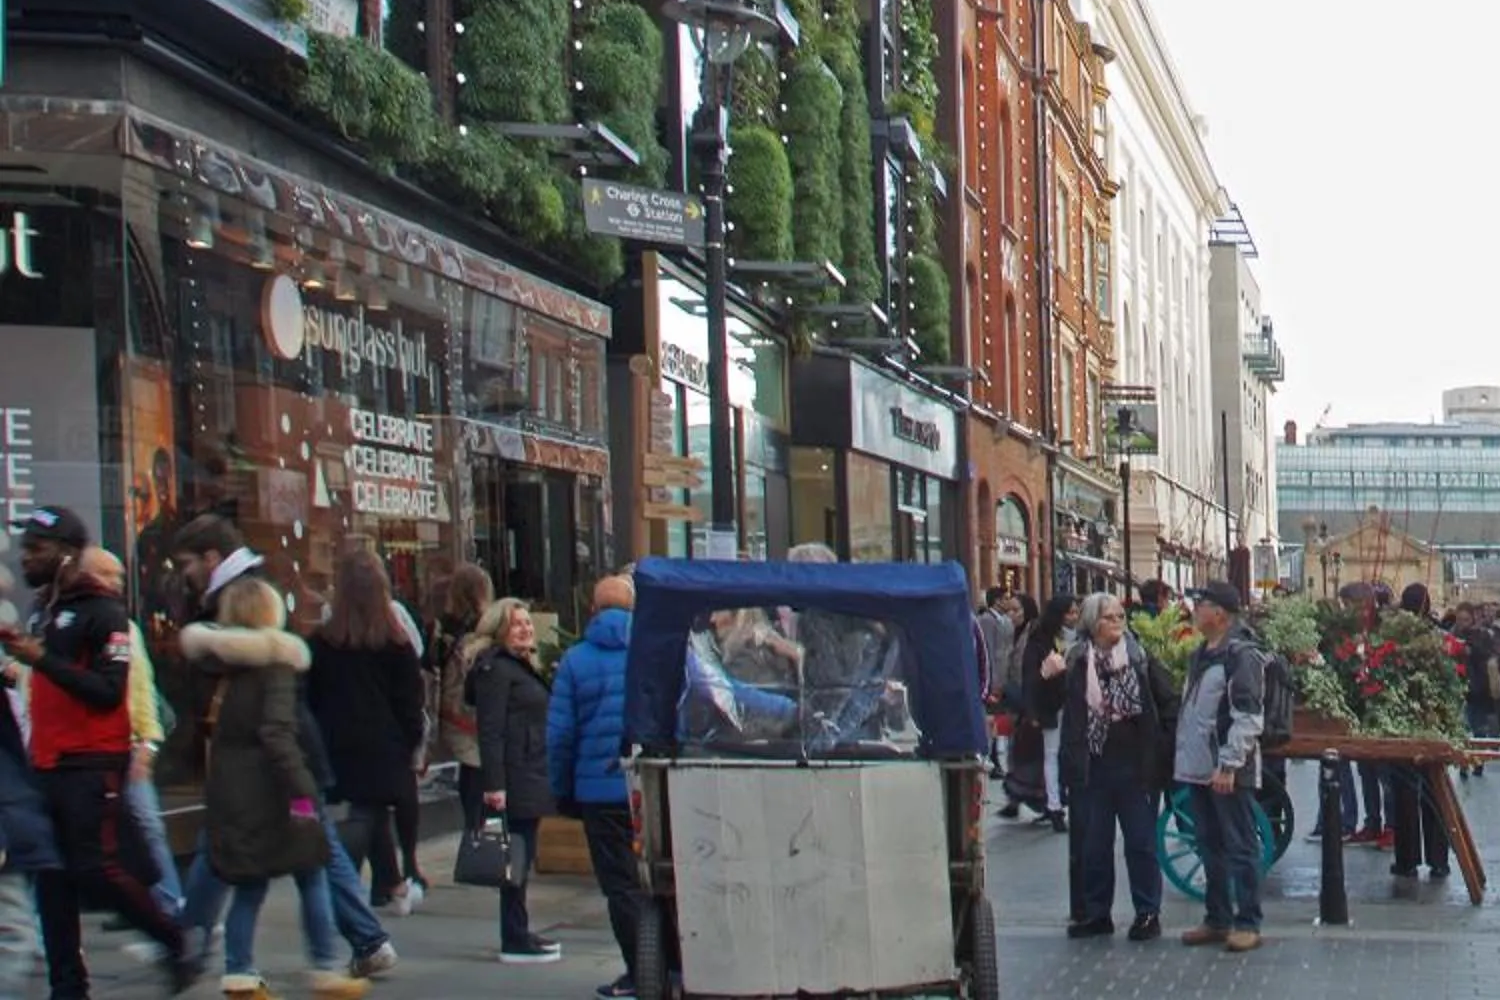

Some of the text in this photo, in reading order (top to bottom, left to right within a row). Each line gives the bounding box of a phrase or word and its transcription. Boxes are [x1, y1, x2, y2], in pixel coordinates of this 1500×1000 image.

[606, 185, 682, 209] Charing Cross
[644, 206, 683, 224] Station
[305, 304, 428, 379] sunglass hut
[350, 408, 433, 452] CELEBRATE
[352, 444, 435, 485] CELEBRATE
[353, 480, 438, 518] CELEBRATE
